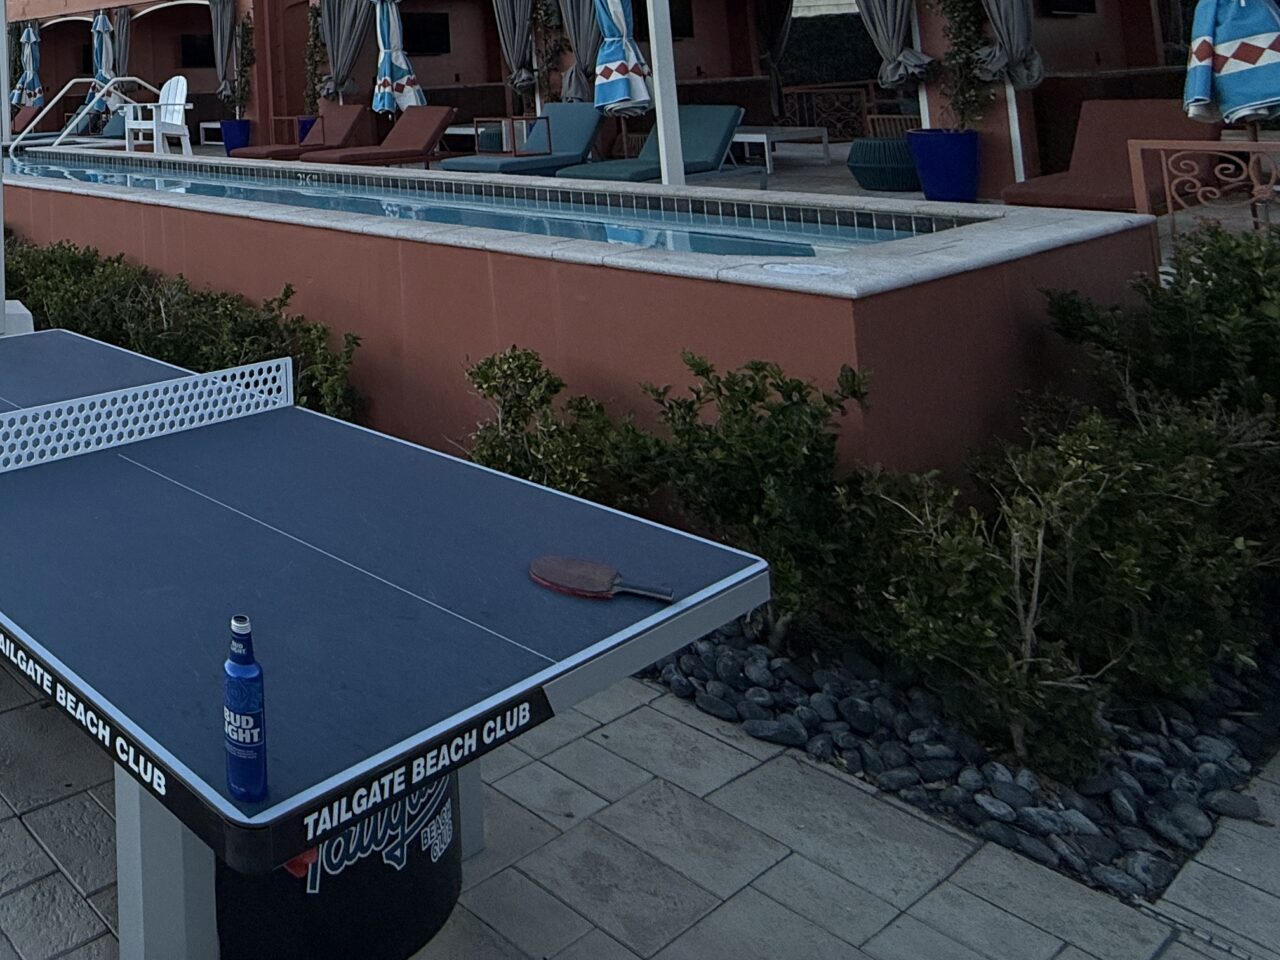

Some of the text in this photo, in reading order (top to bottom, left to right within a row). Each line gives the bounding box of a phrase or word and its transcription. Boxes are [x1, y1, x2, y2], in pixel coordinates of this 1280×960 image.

[56, 683, 111, 747] BEACH
[115, 736, 167, 796] CLUB
[223, 705, 254, 729] BUD
[224, 720, 260, 743] IGHT
[303, 702, 531, 841] TAILGATE BEACH CLUB
